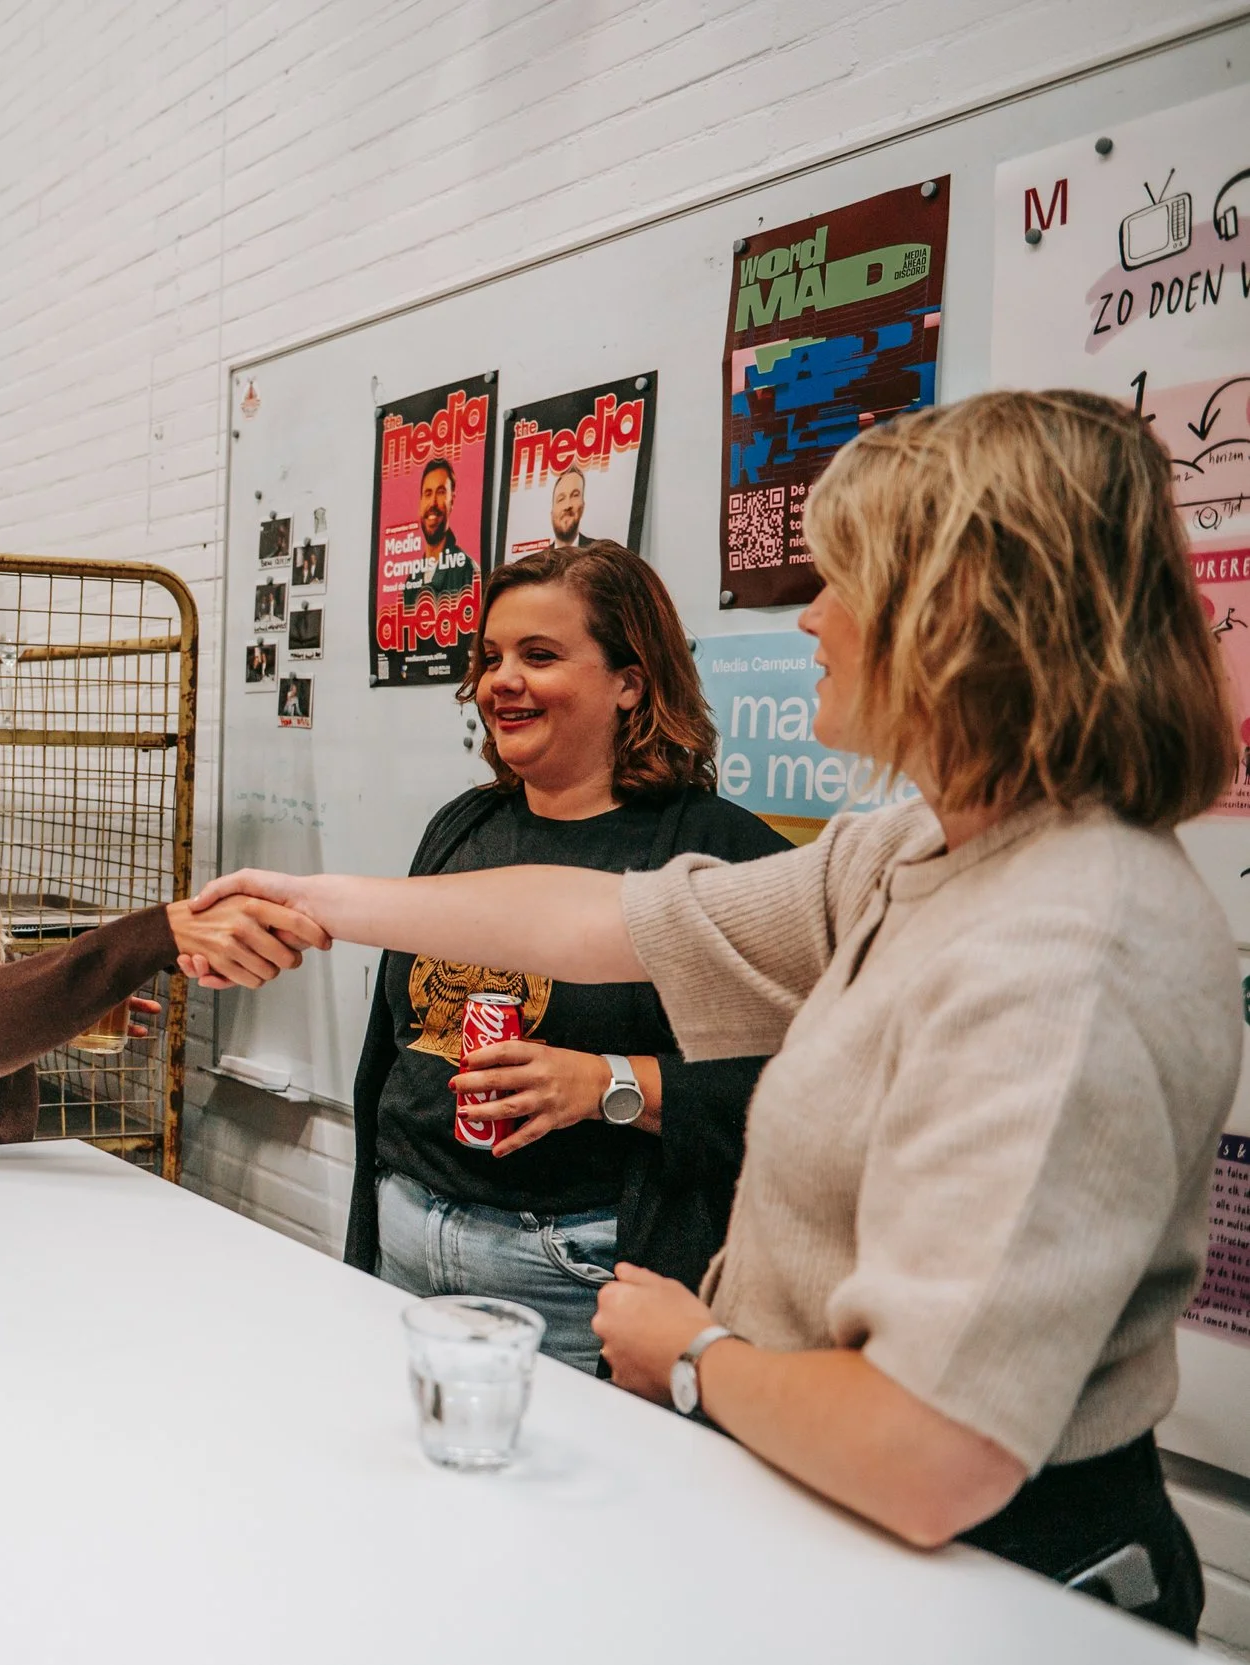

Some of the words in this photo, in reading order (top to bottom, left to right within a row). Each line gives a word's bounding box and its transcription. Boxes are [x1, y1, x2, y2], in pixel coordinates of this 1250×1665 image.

[1024, 178, 1068, 235] M
[902, 257, 927, 271] AHEAD
[904, 248, 927, 260] MEDIA
[894, 265, 926, 281] DISCORD
[1093, 289, 1133, 335] ZO
[1149, 263, 1225, 319] DOEN
[381, 389, 490, 467] media
[511, 393, 645, 477] media
[514, 418, 539, 437] the
[1209, 452, 1244, 464] horizon
[1184, 472, 1194, 482] 2
[790, 482, 806, 497] Dé
[384, 532, 422, 556] Media
[383, 556, 436, 580] Campus
[438, 548, 466, 570] Live
[1194, 558, 1250, 579] URERE
[376, 580, 482, 653] ahead
[712, 658, 749, 673] Media
[751, 656, 807, 673] Campus
